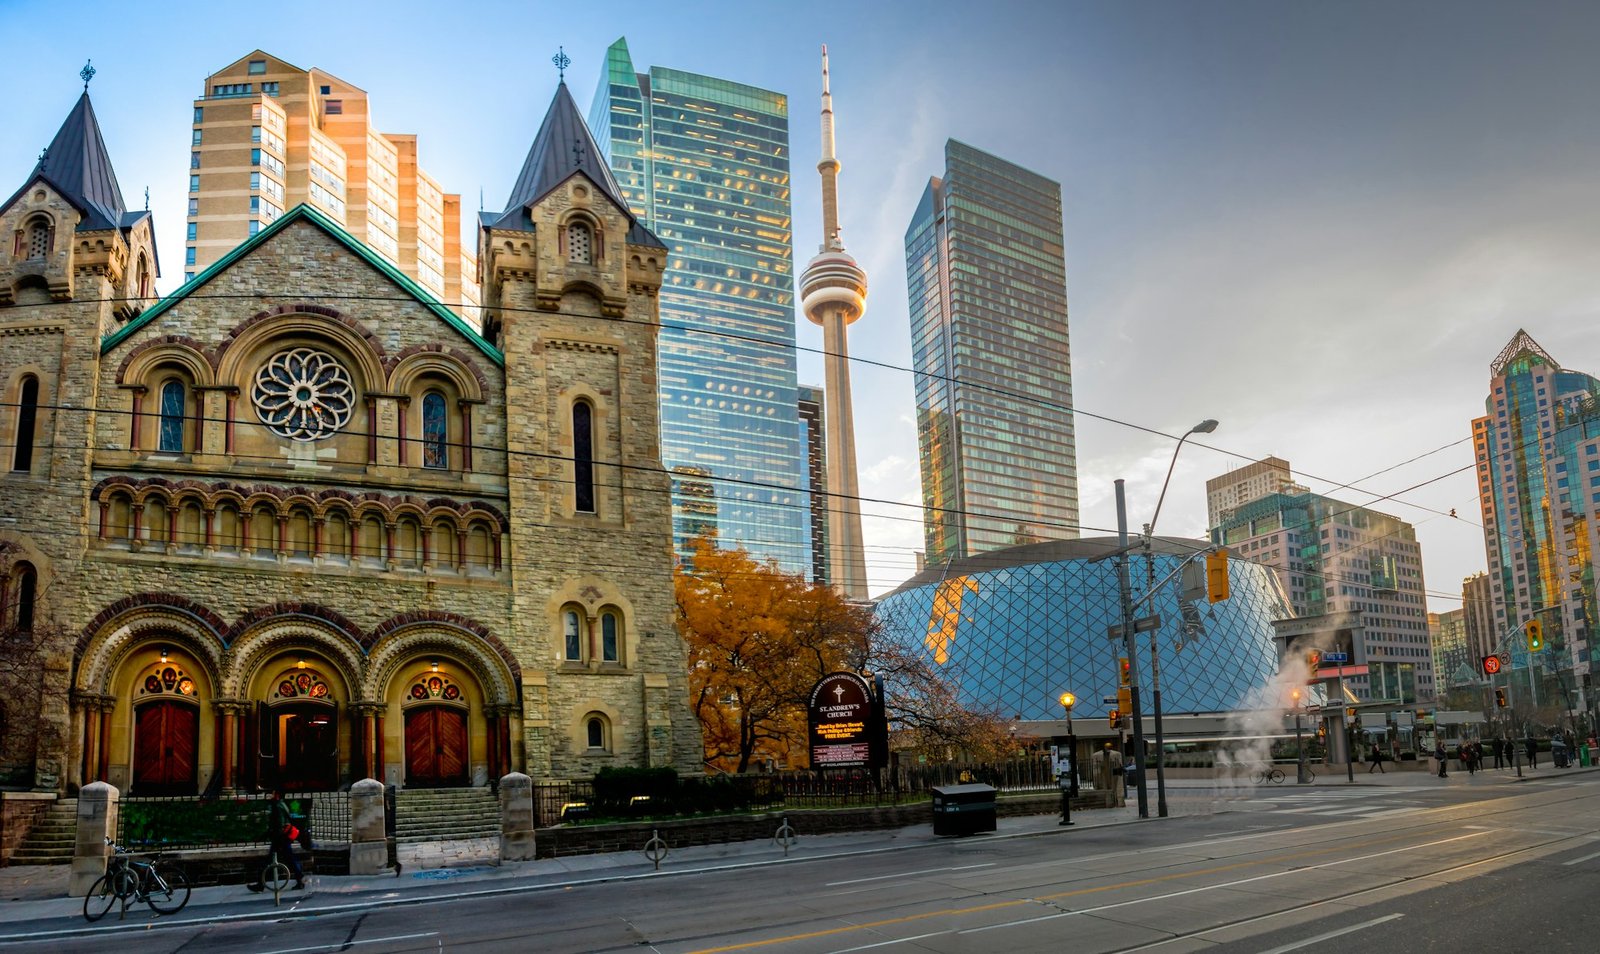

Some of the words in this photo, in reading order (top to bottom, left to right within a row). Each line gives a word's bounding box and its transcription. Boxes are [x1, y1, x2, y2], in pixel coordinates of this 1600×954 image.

[812, 675, 838, 698] PRESBYTERIAN
[838, 674, 857, 683] CHURCH
[859, 684, 869, 704] CANADA
[827, 711, 853, 719] CHURCH
